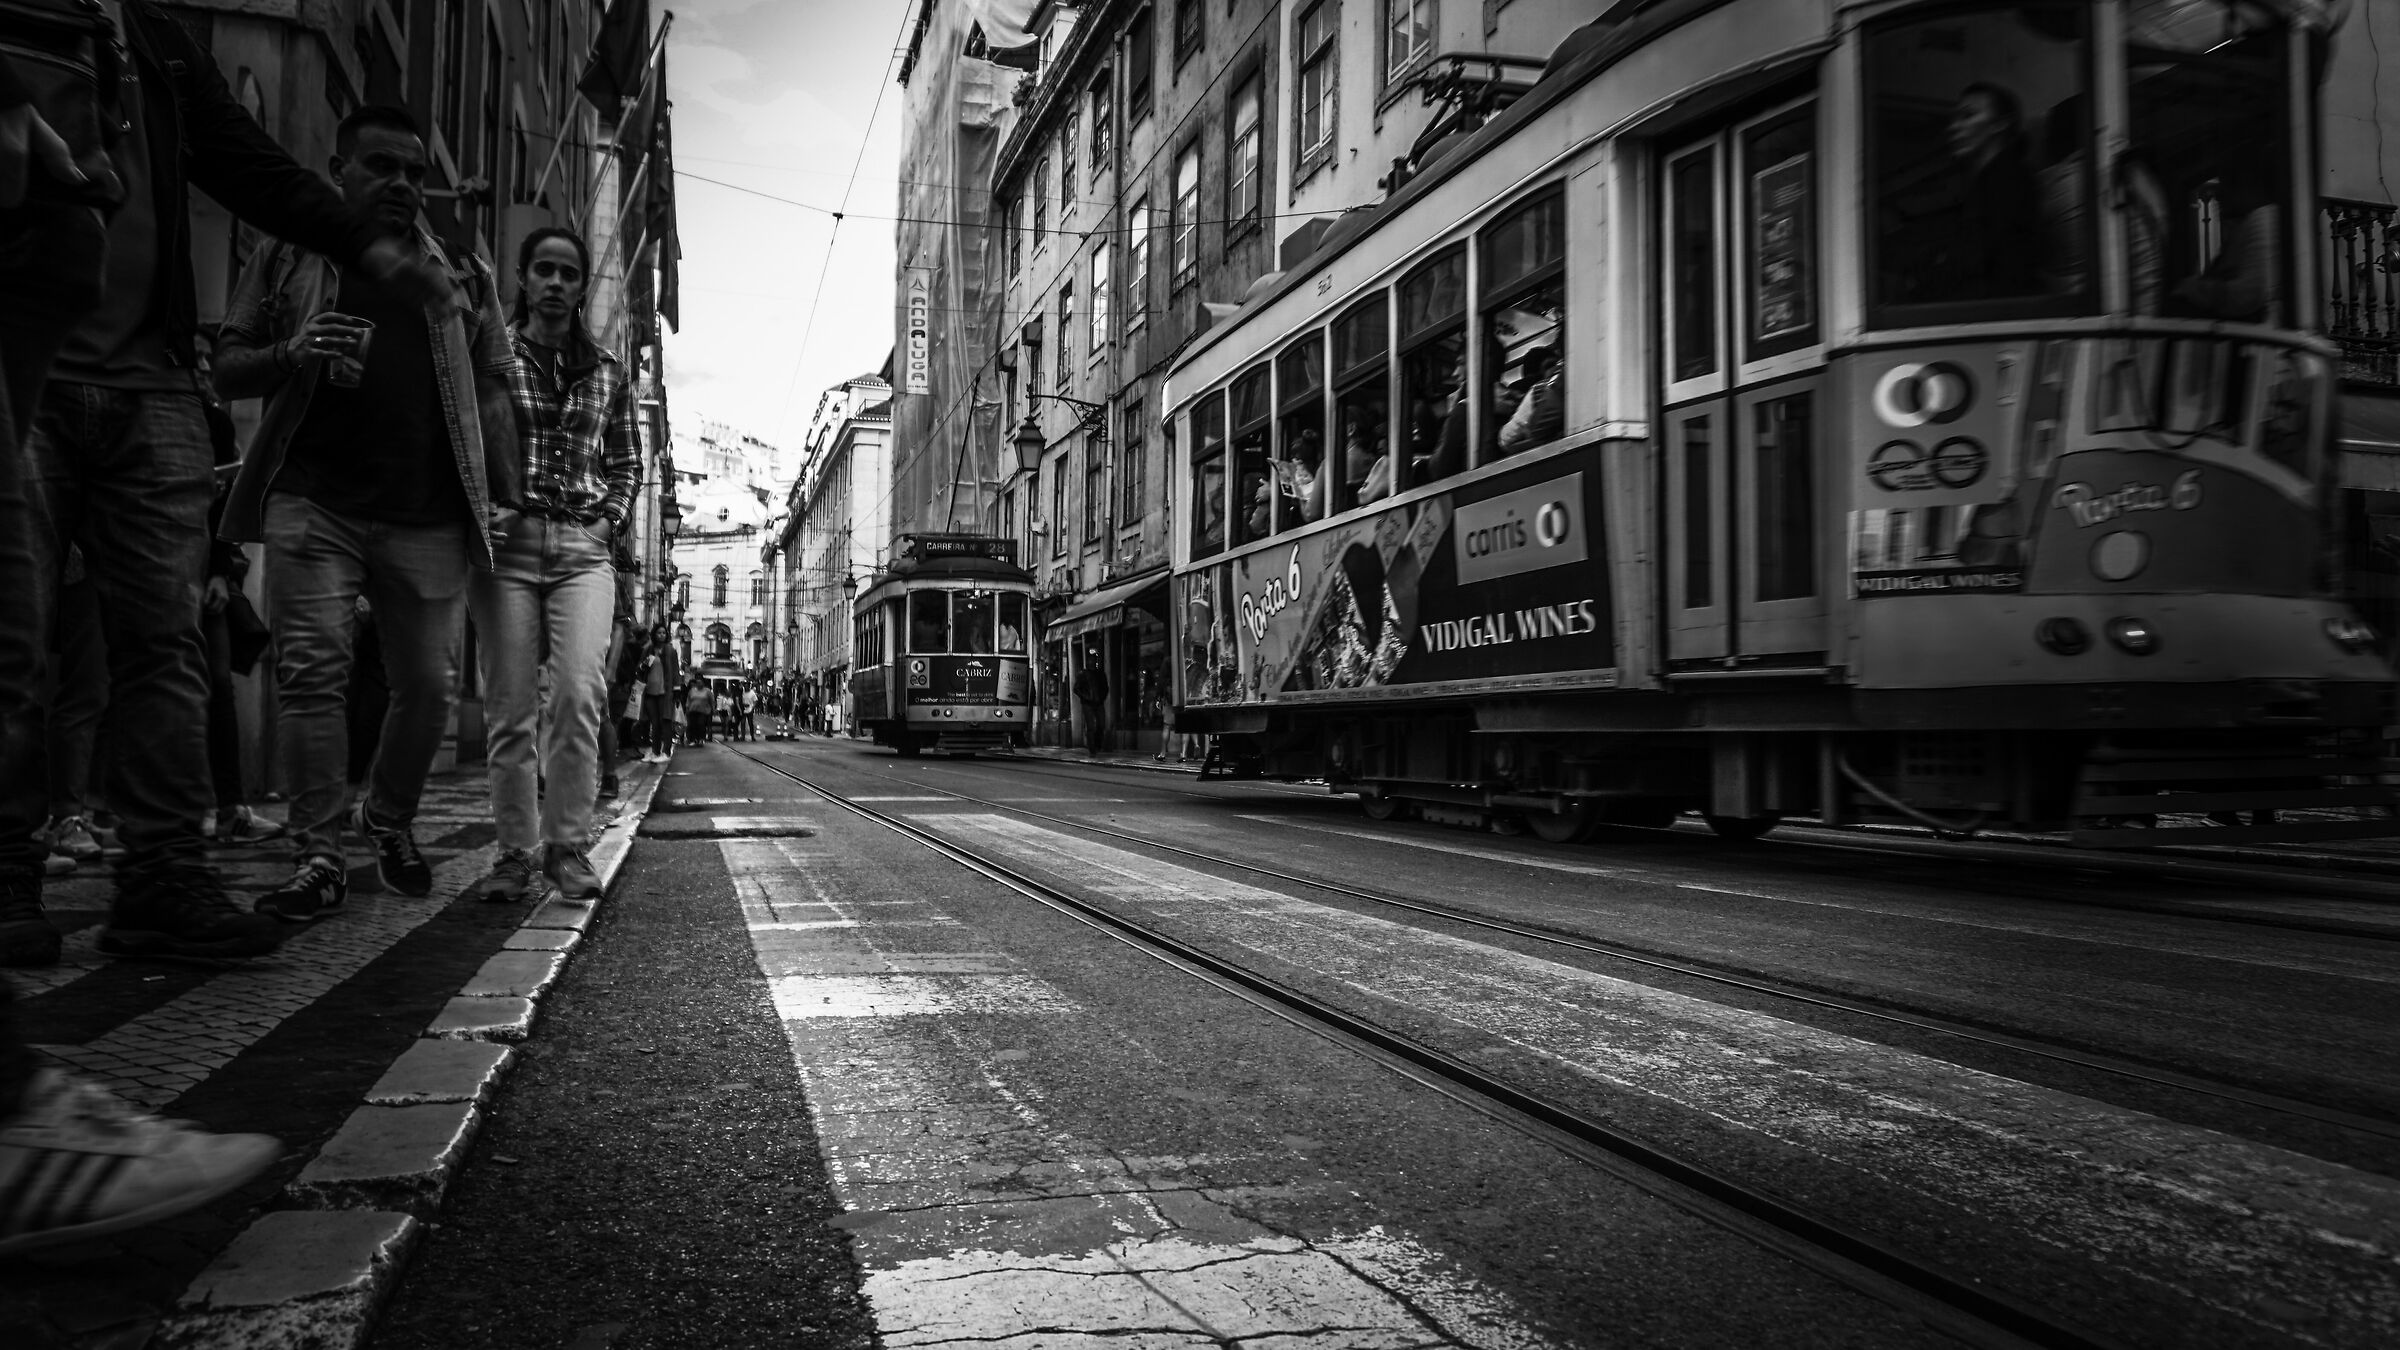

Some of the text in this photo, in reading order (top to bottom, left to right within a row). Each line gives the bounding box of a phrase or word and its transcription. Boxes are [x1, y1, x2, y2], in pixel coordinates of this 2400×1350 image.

[911, 297, 926, 382] ANDALUGA
[2170, 467, 2205, 512] 6
[926, 542, 965, 551] CARREIRA
[989, 542, 1005, 553] 28
[1465, 509, 1527, 559] carris
[1240, 577, 1287, 647] Porta
[1288, 542, 1302, 602] 6
[1420, 598, 1597, 654] VIDIGAL WINES
[956, 668, 992, 678] CABRIZ
